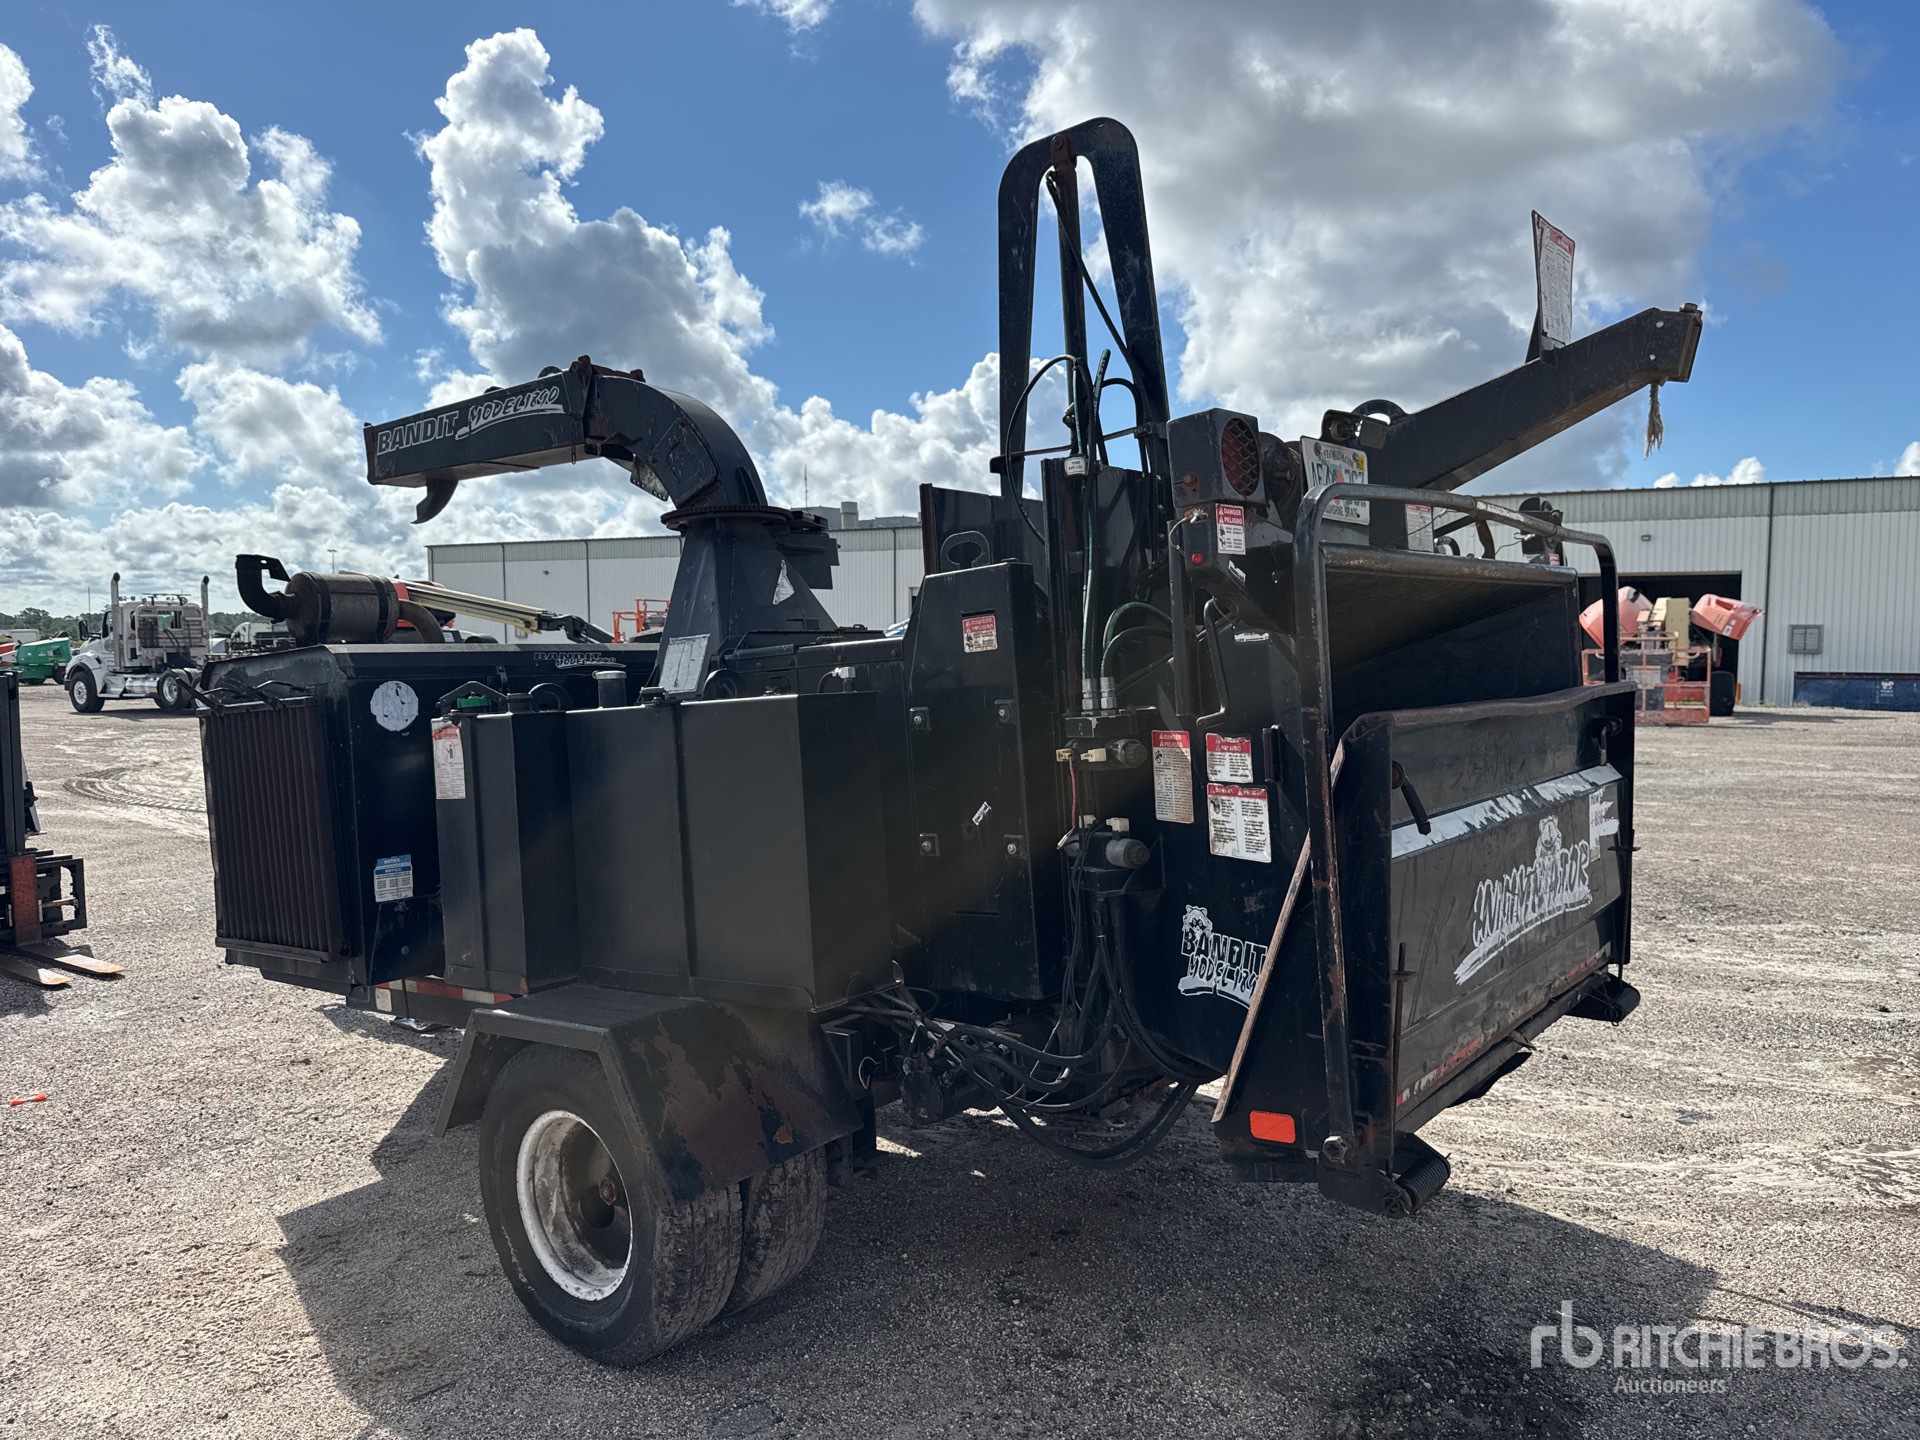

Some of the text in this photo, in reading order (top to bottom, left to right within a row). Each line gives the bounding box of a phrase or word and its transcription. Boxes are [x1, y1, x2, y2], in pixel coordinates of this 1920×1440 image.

[377, 386, 560, 456] BANDIT MODEL 1890
[1223, 508, 1241, 516] DANGER
[1224, 516, 1242, 524] PELIGRO
[534, 652, 602, 660] BANDIT
[1181, 928, 1267, 972] BANDIT
[1189, 953, 1228, 988] MODEL
